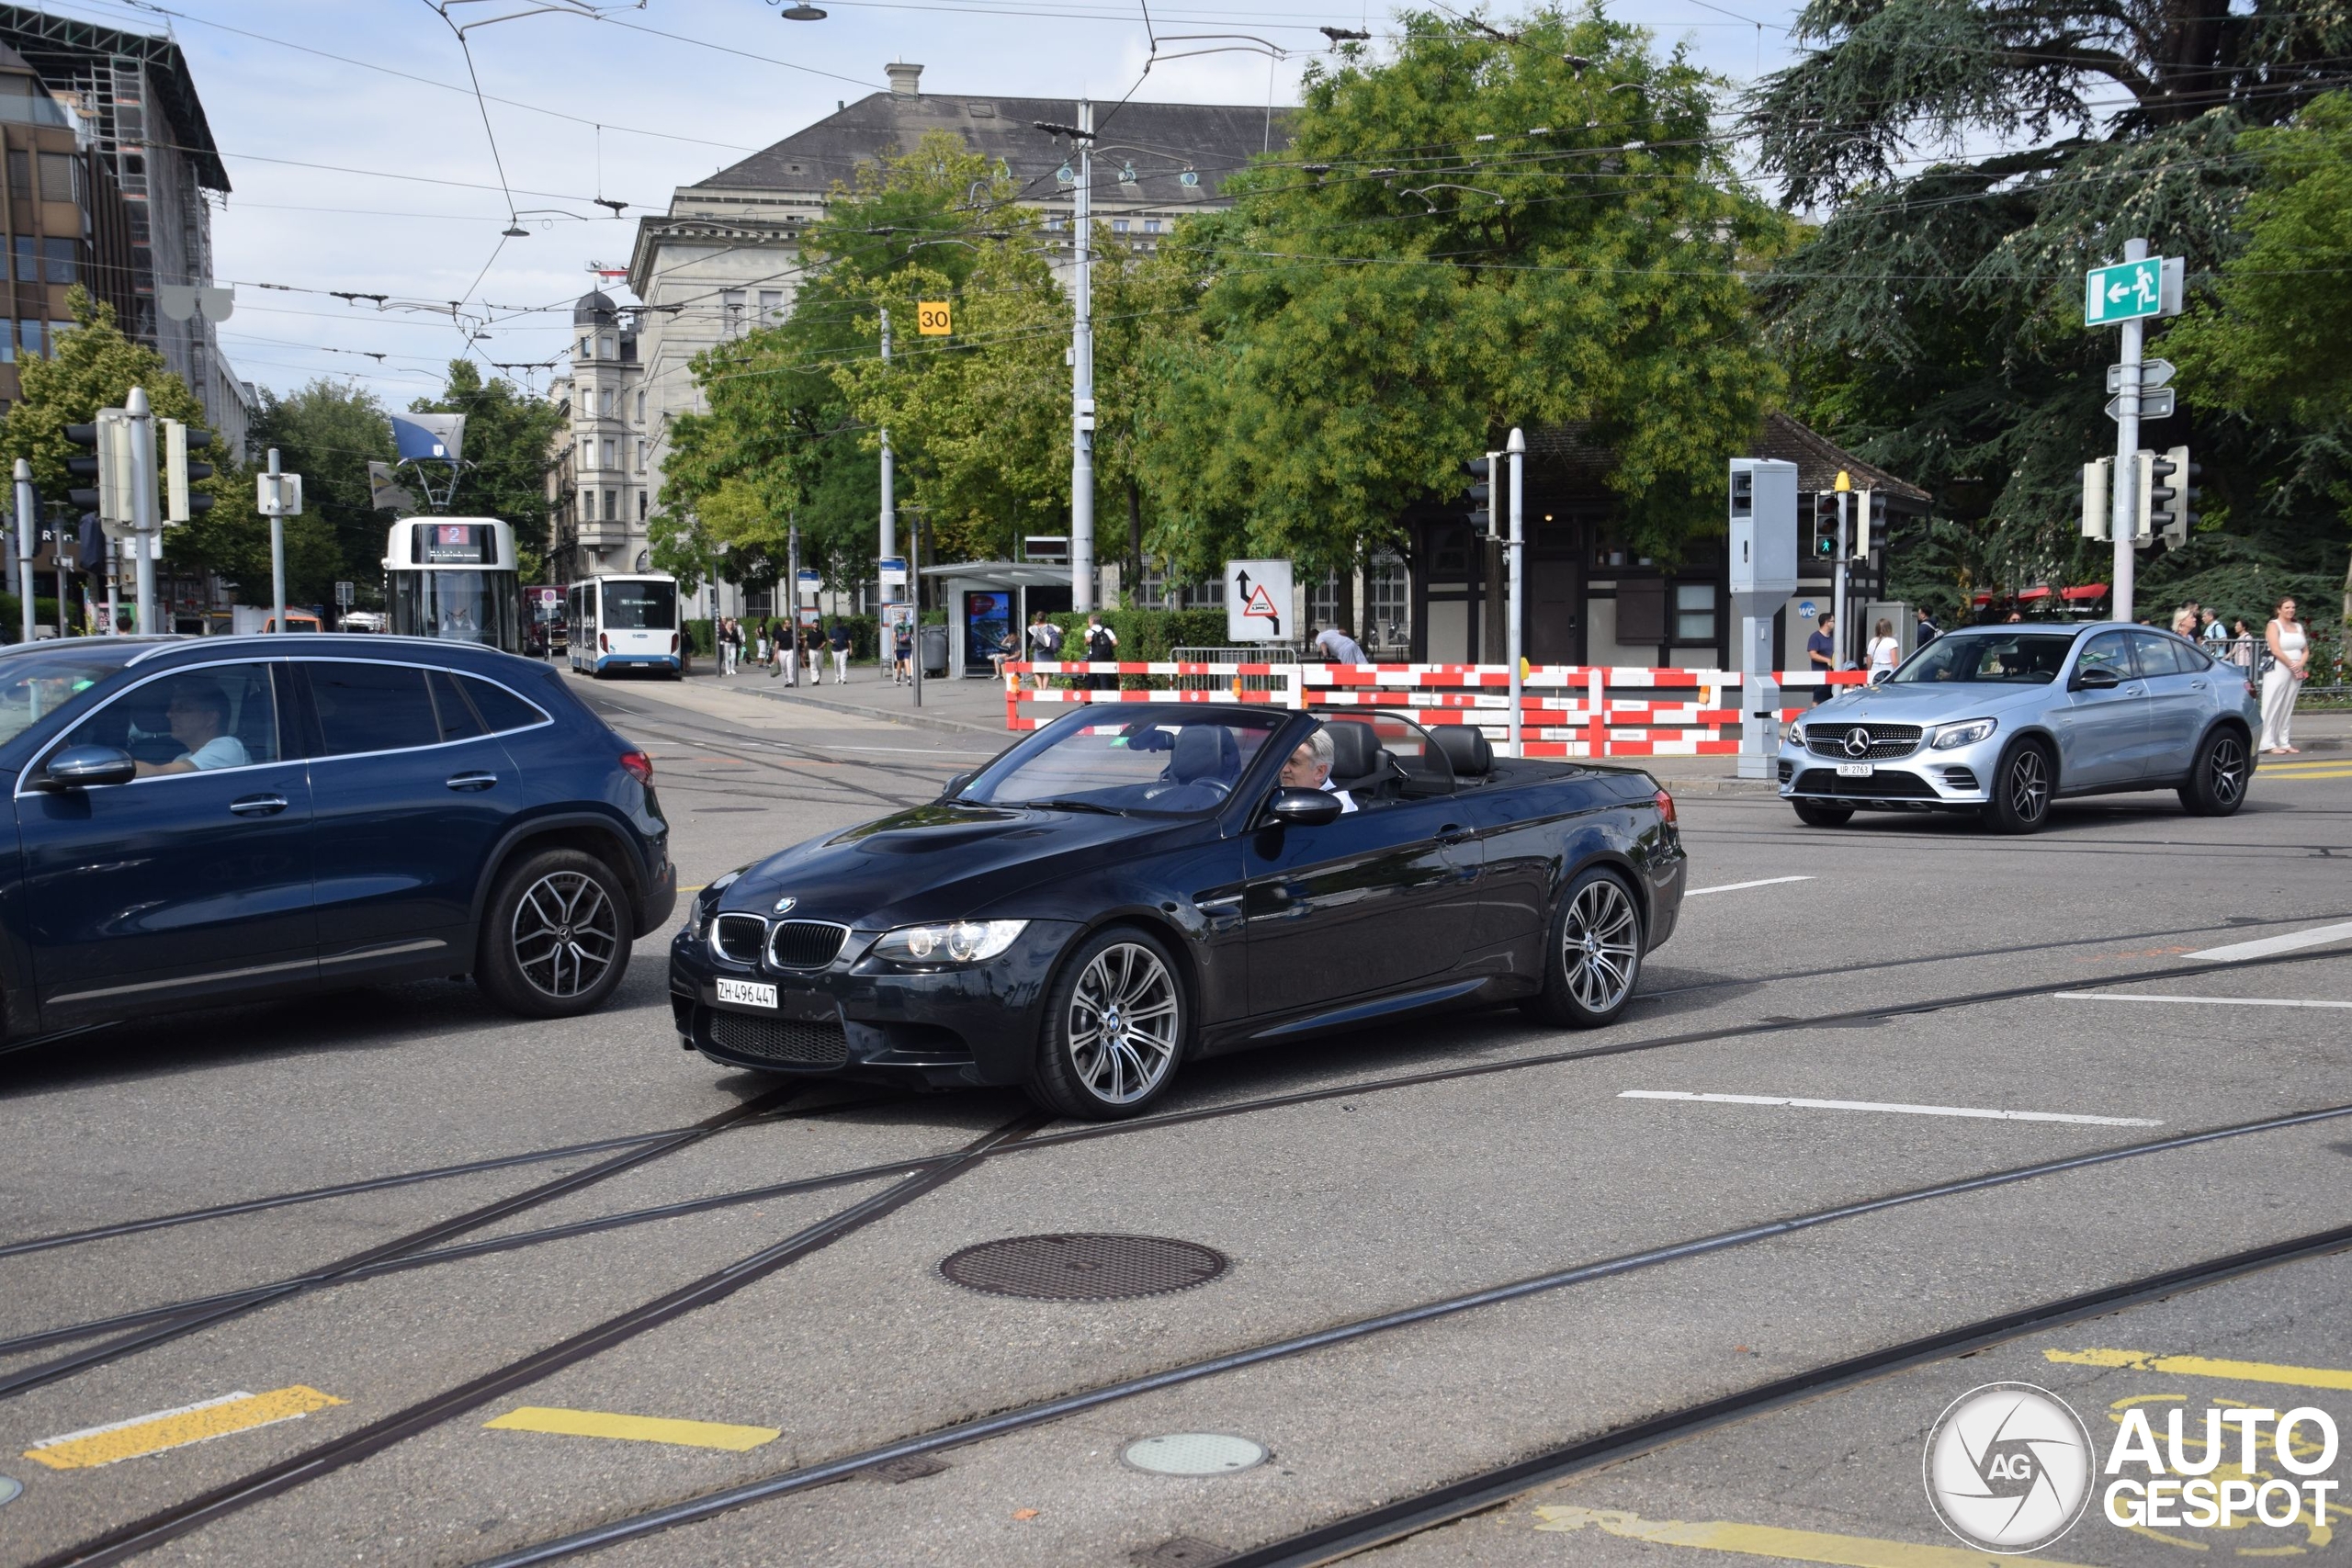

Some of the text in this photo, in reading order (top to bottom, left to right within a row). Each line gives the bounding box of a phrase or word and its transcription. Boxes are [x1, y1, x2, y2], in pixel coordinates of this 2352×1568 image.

[922, 310, 948, 328] 30
[448, 526, 460, 543] 2
[1798, 607, 1816, 617] WC
